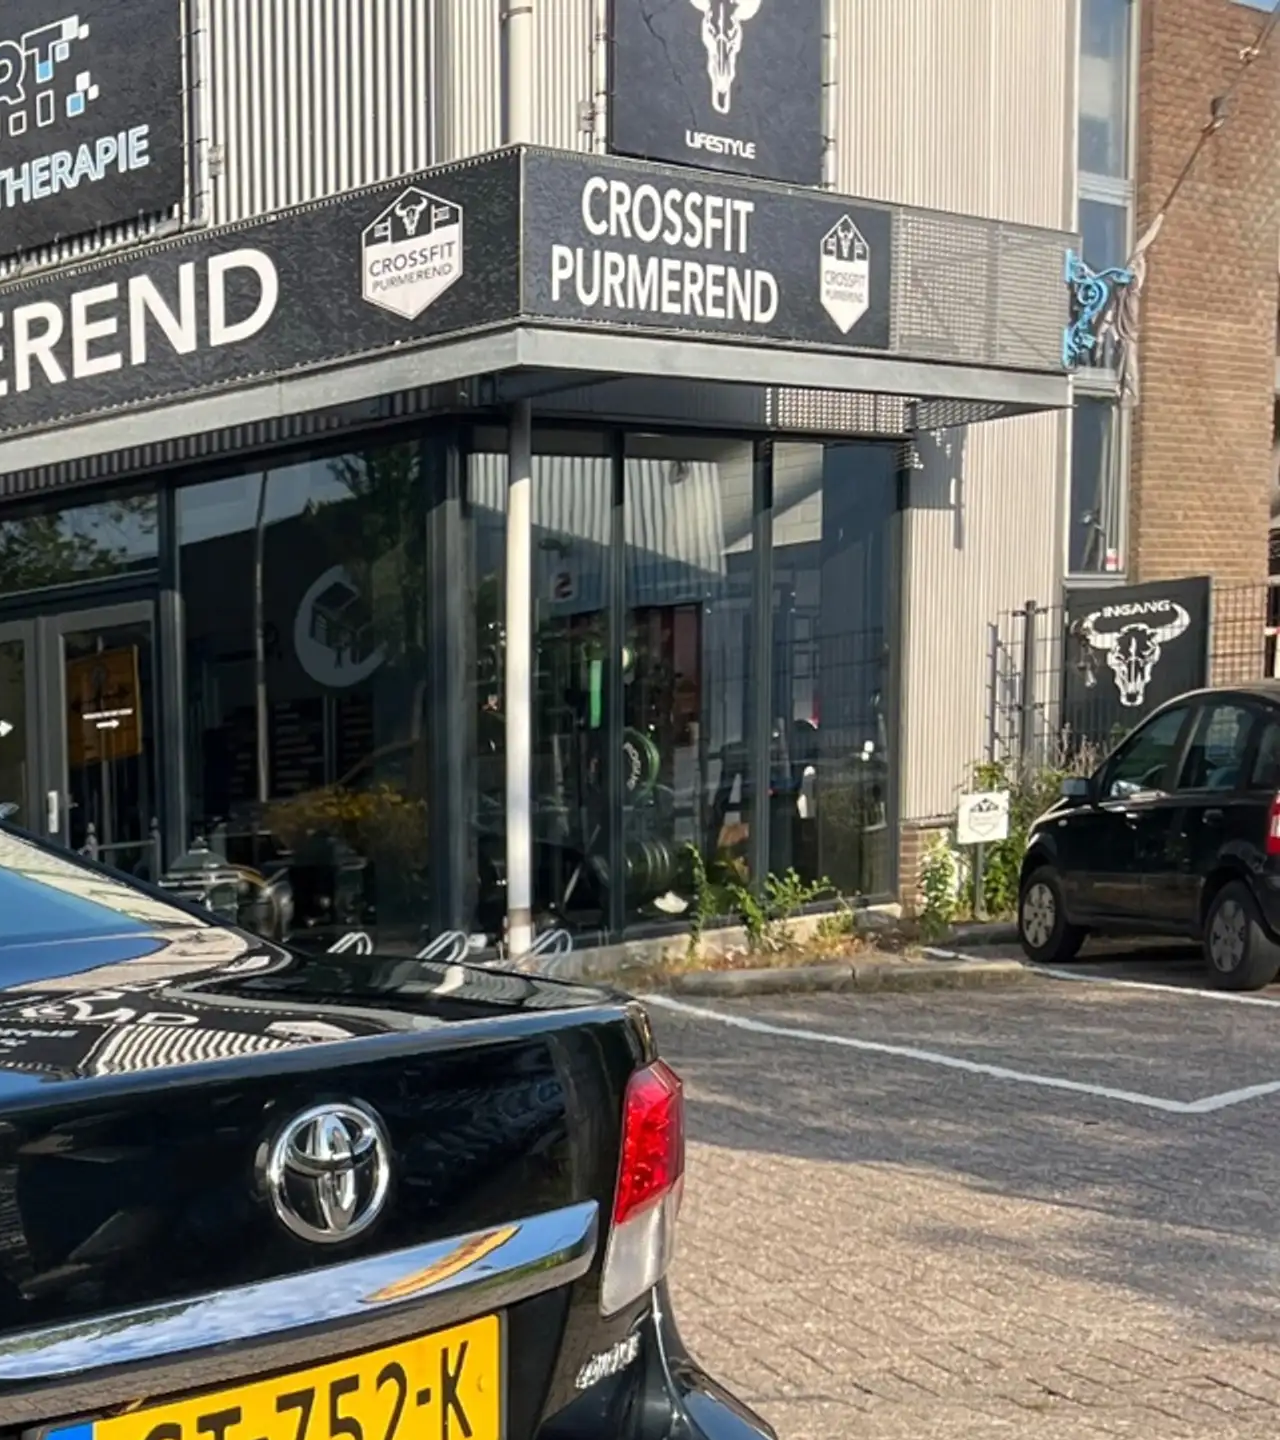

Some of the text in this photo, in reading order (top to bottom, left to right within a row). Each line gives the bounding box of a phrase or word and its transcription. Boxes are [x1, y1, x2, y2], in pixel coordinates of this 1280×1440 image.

[686, 129, 756, 159] LIFESTYLE
[582, 175, 754, 253] CROSSFIT
[369, 241, 455, 277] CROSSFIT
[372, 263, 453, 293] PURMEREND
[550, 244, 778, 325] PURMEREND
